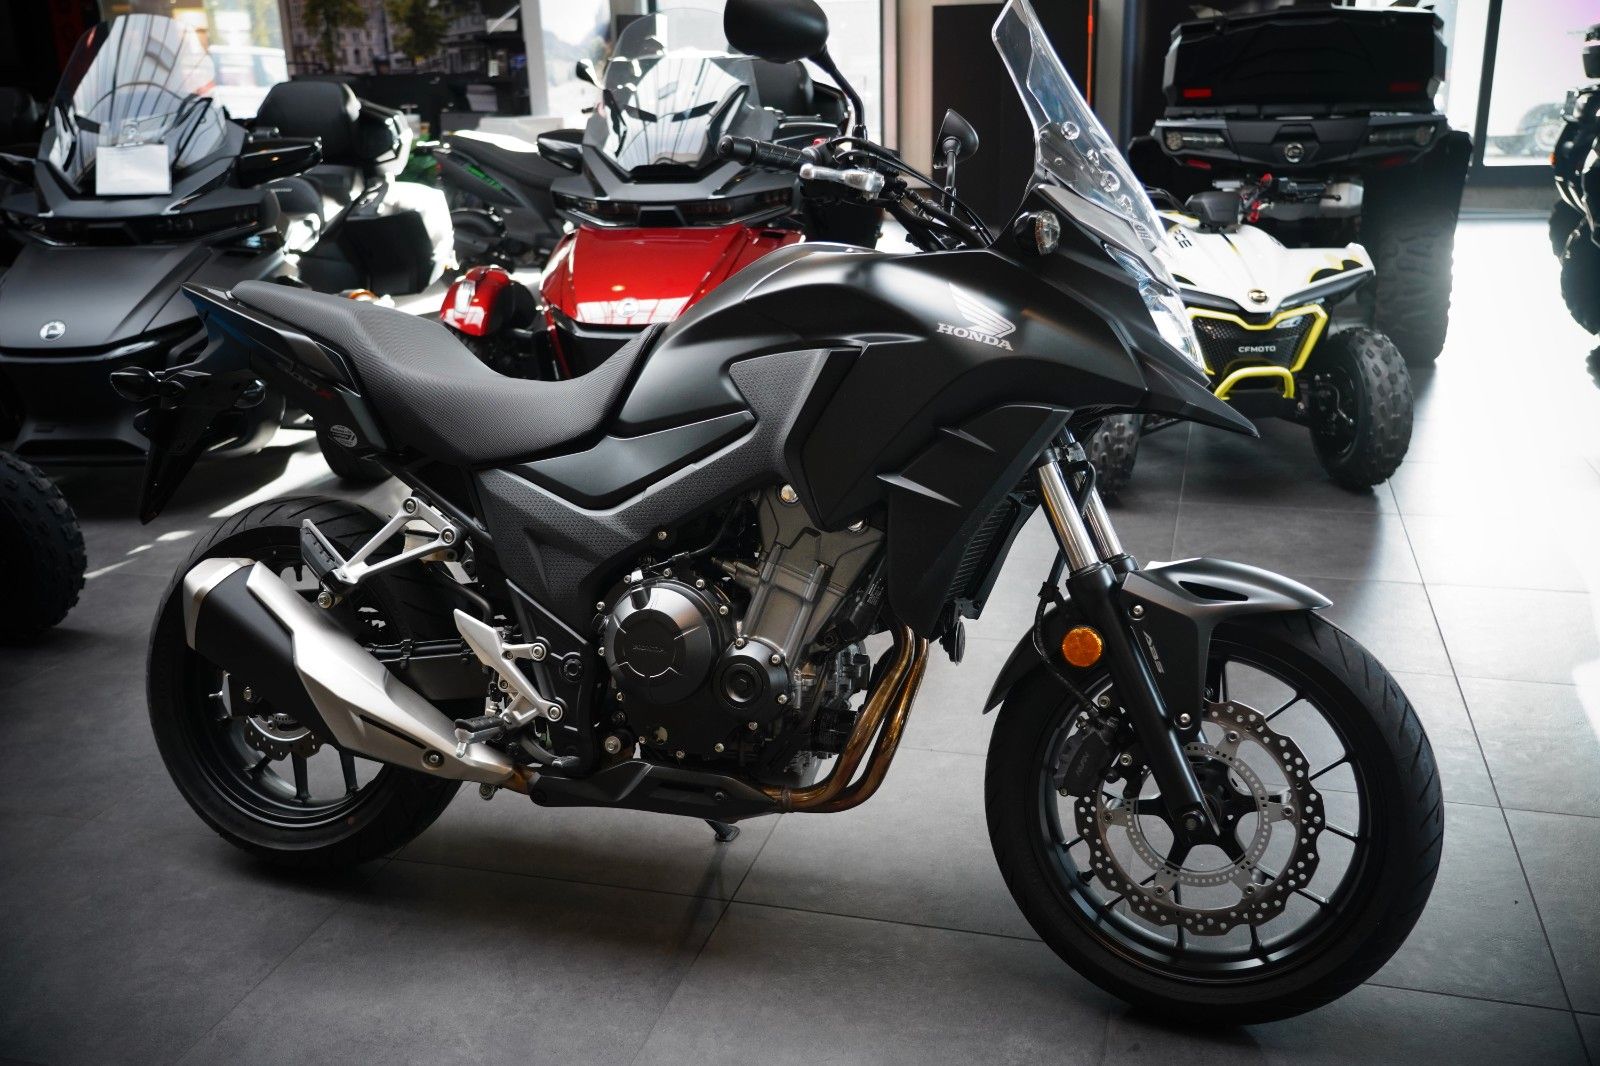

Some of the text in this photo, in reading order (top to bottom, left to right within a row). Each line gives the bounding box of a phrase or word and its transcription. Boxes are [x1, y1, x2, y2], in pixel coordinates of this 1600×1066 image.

[936, 322, 1014, 351] HONDA
[1237, 345, 1277, 353] CFMOTO
[1143, 629, 1165, 674] ABS
